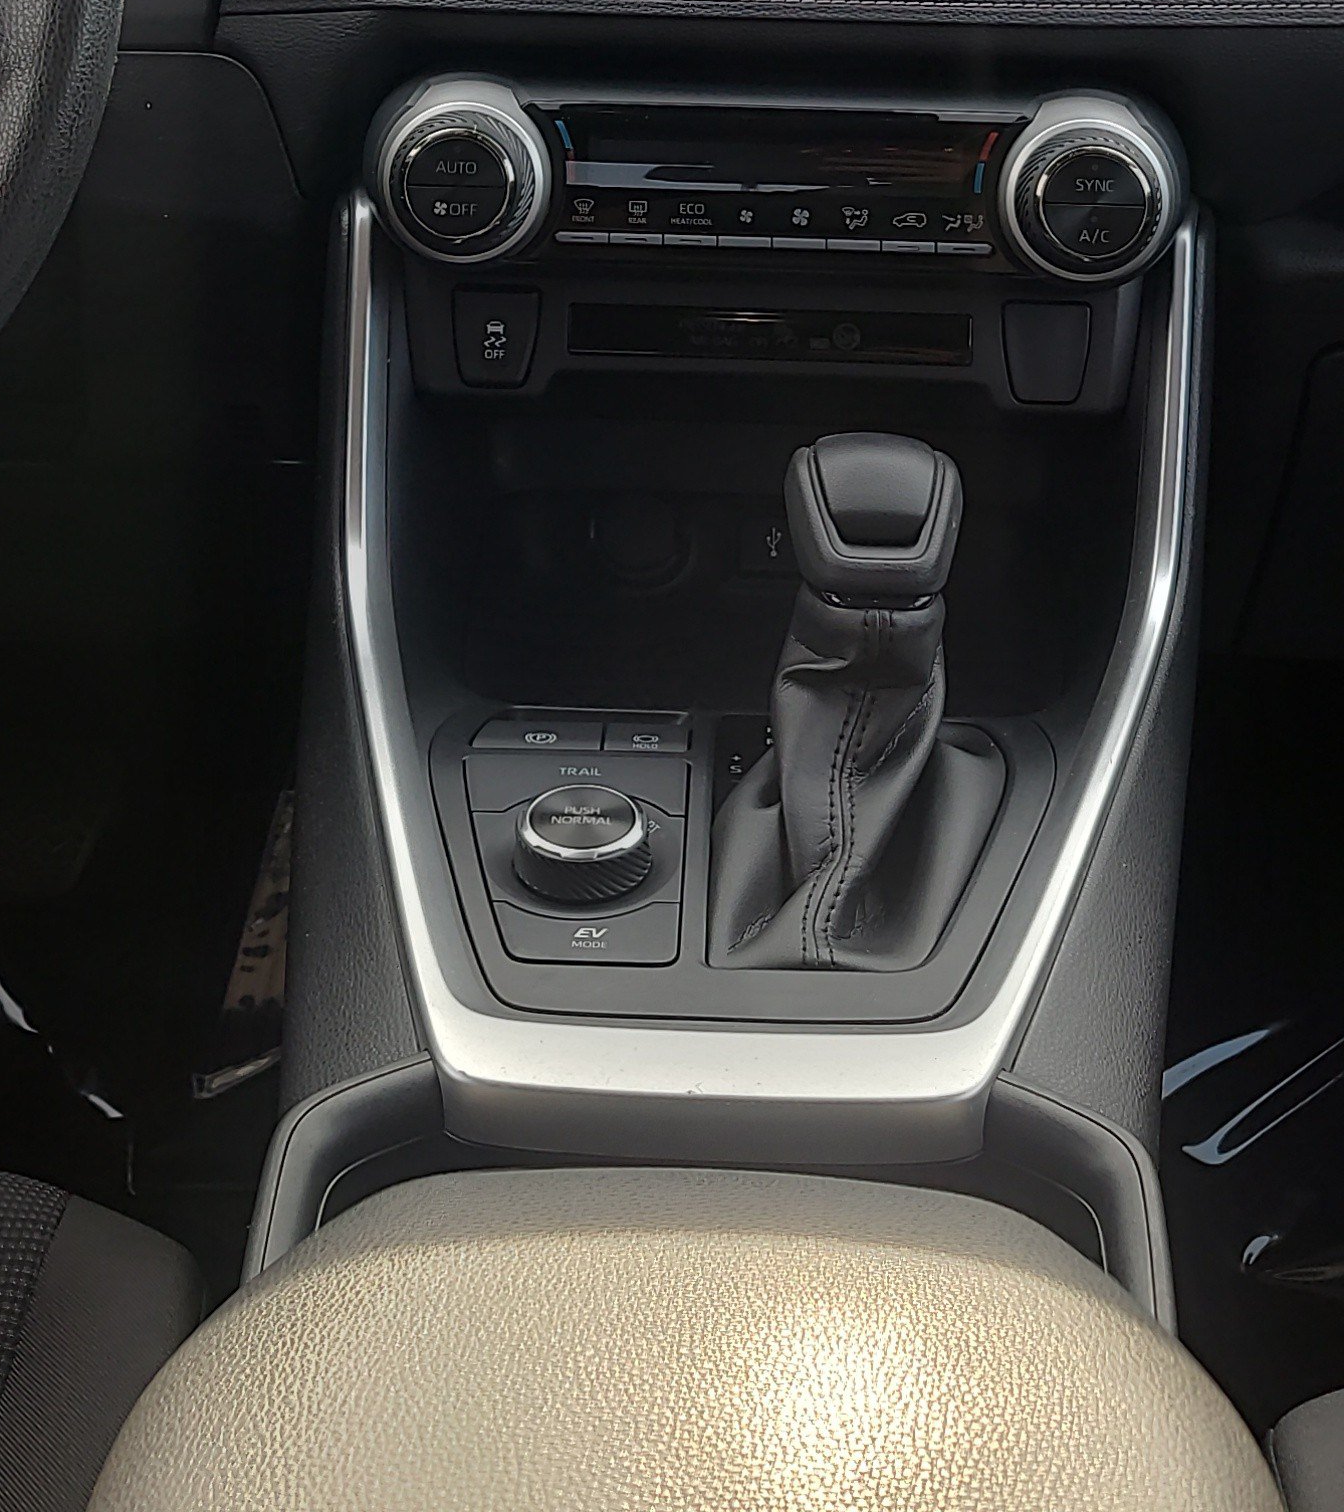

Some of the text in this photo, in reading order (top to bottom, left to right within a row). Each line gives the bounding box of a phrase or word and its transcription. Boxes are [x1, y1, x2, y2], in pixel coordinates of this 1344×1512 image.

[435, 160, 478, 175] AUTO
[1075, 179, 1115, 192] SYNC
[449, 202, 479, 217] OFF
[679, 203, 705, 215] ECO
[670, 218, 714, 226] HEAT/COOL
[1079, 229, 1110, 244] A/C
[484, 348, 506, 360] OFF
[632, 742, 659, 750] HOLD
[559, 767, 602, 776] TRAIL
[564, 806, 601, 815] PUSH
[550, 815, 612, 825] NORMAL
[574, 927, 609, 939] EV
[571, 940, 607, 949] MODE
